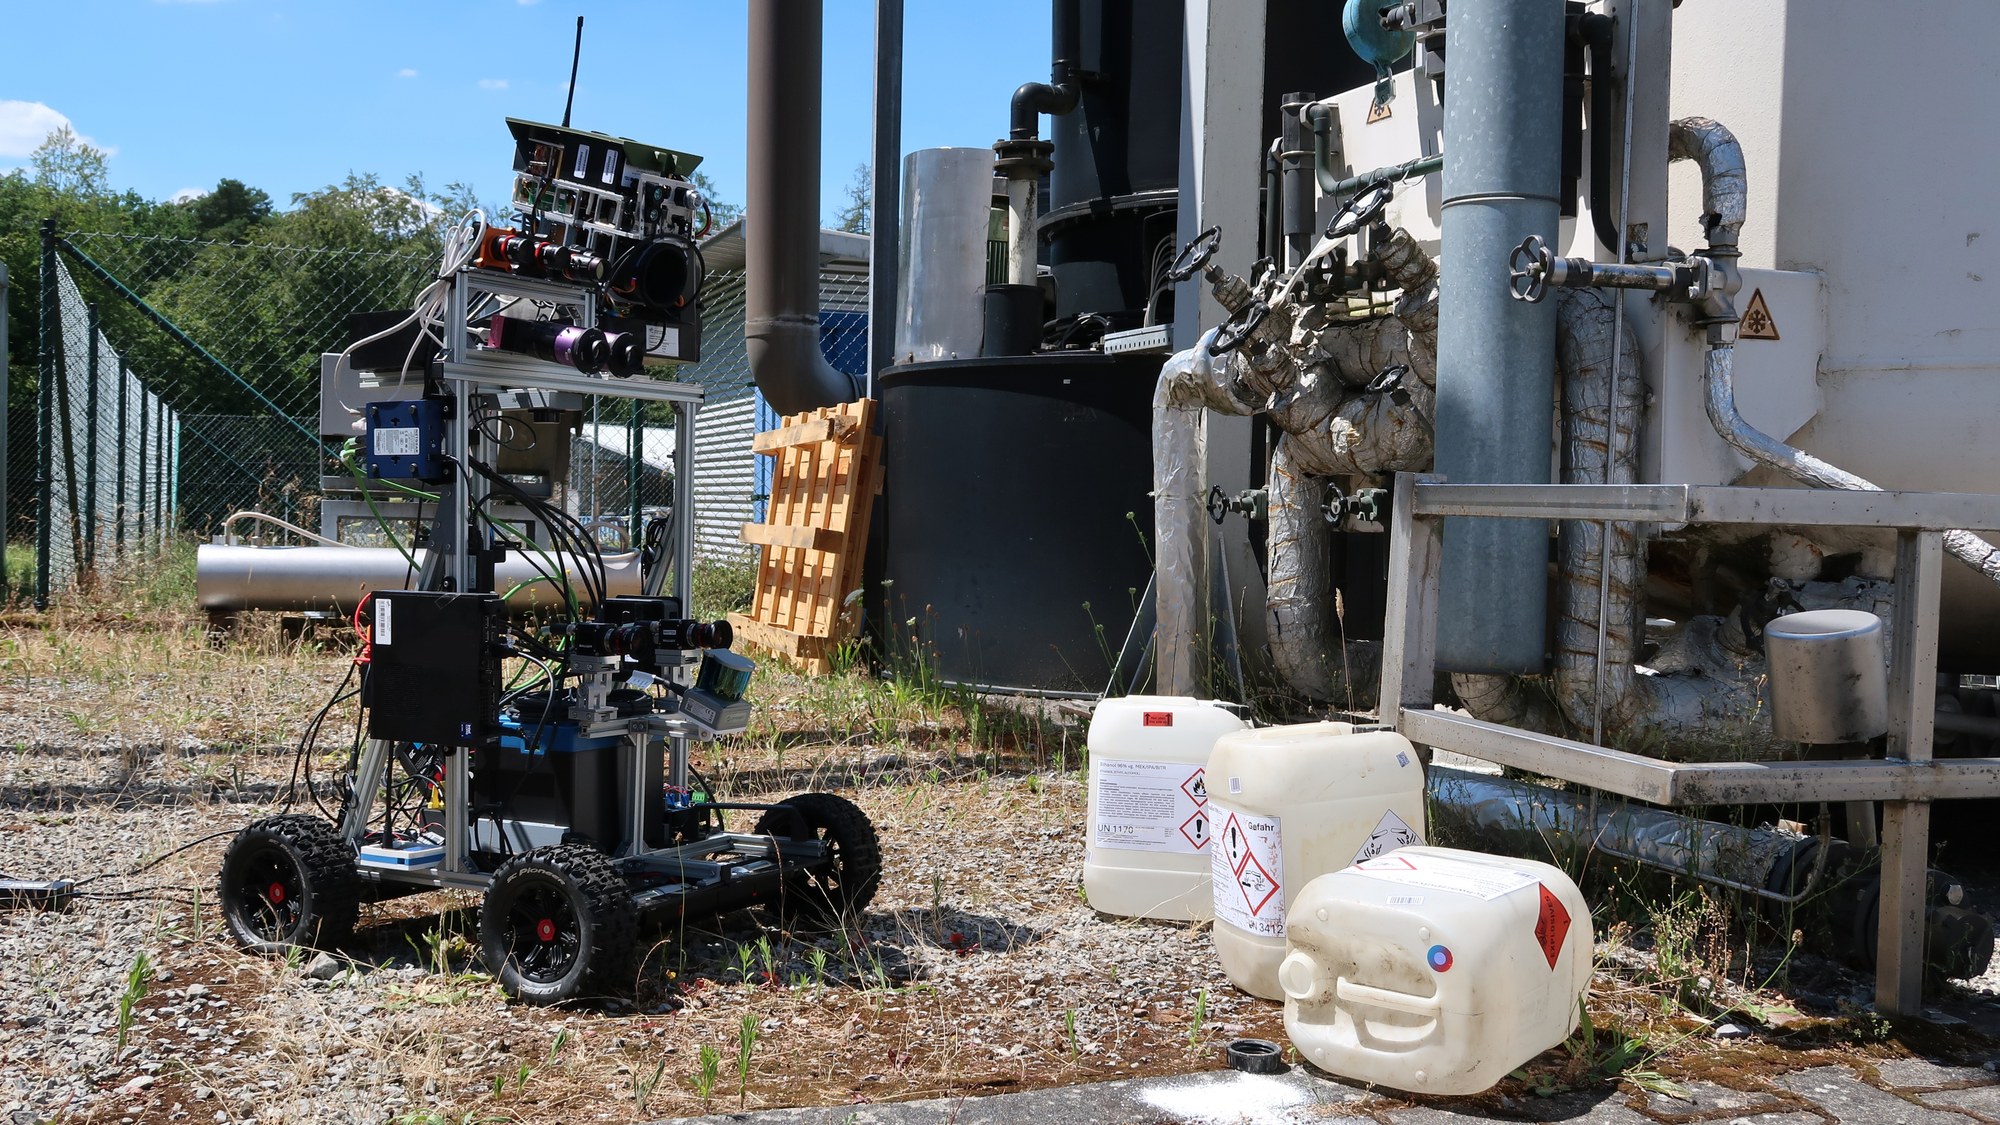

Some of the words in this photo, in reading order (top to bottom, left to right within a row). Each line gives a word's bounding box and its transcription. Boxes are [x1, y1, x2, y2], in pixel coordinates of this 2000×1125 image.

[1097, 824, 1110, 832] UN
[1112, 825, 1134, 834] 1170
[1248, 821, 1275, 831] Gefahr
[1259, 922, 1284, 934] 3412
[1544, 895, 1555, 958] EXPLOSIVES
